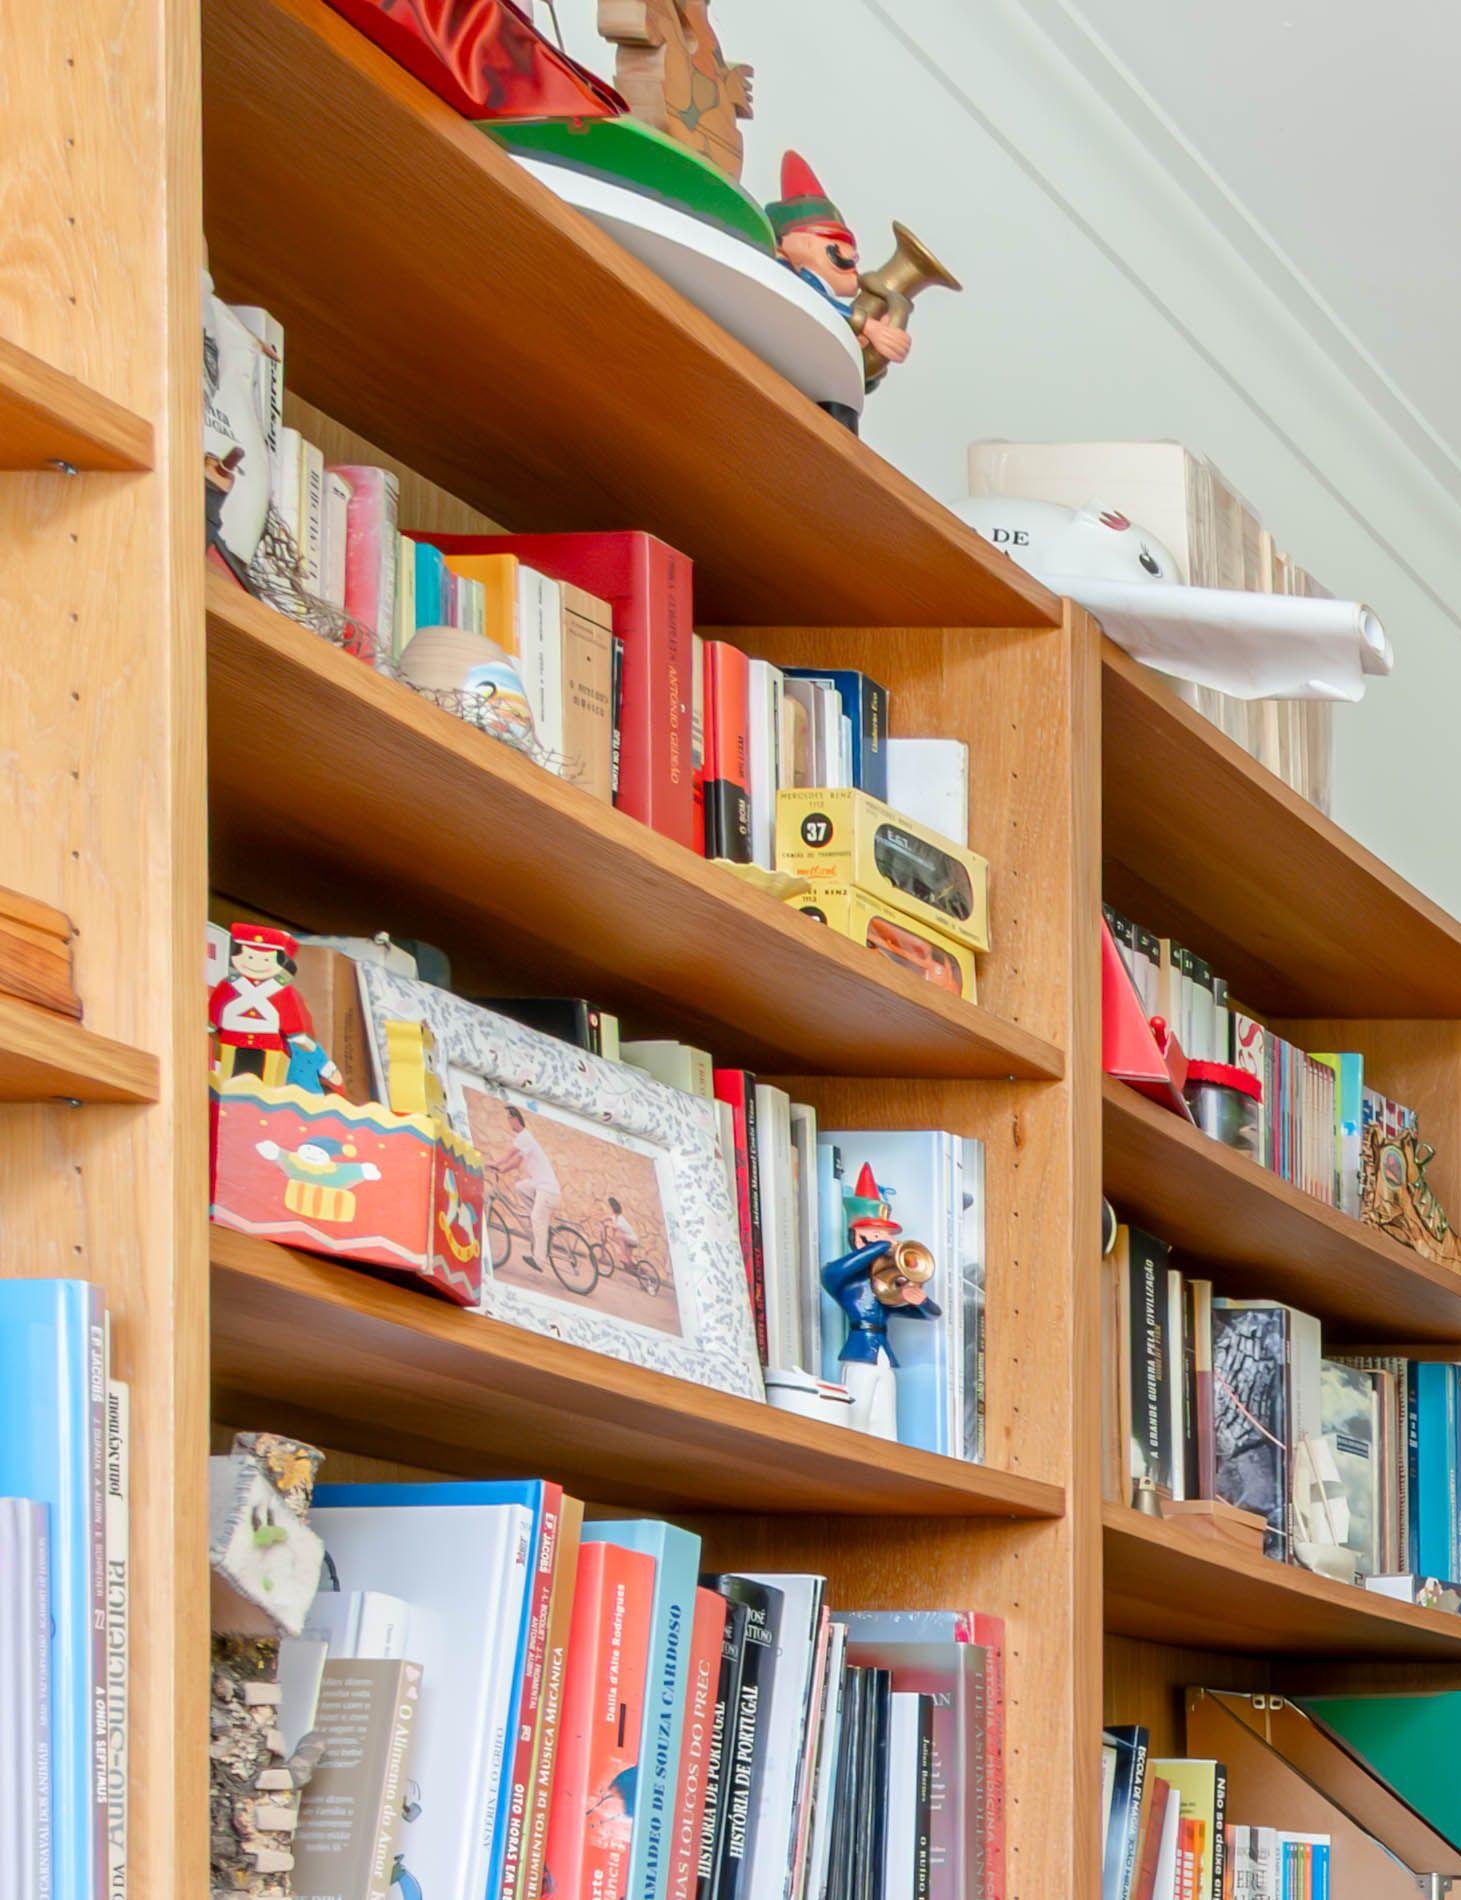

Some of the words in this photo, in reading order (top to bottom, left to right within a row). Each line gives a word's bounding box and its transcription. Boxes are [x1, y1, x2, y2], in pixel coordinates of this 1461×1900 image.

[993, 528, 1030, 547] DE
[806, 822, 827, 842] 37
[1145, 1258, 1155, 1325] CIVILIZAÇÃO
[1147, 1360, 1158, 1402] GUERRA
[1149, 1405, 1160, 1448] GRANDE
[539, 1533, 555, 1574] JACOBS
[613, 1584, 626, 1651] Rodrigues
[609, 1655, 621, 1688] d'Alte
[660, 1604, 683, 1707] CARDOSO
[606, 1691, 618, 1723] Dalila
[695, 1659, 712, 1723] PREC
[95, 1701, 107, 1735] ONDA
[399, 1704, 413, 1720] O
[741, 1685, 759, 1757] PORTUGAL
[654, 1714, 673, 1778] SOUZA
[689, 1731, 705, 1765] DO
[96, 1740, 108, 1804] SEPTIMUS
[736, 1760, 750, 1789] DE
[511, 1783, 524, 1813] OITO
[651, 1783, 665, 1817] DE
[1216, 1777, 1227, 1809] Não
[383, 1803, 398, 1829] do
[679, 1773, 700, 1862] LOUCOS
[730, 1793, 746, 1860] HISTÓRIA
[1215, 1811, 1225, 1831] se
[374, 1833, 394, 1878] Amor
[507, 1817, 522, 1860] HORAS
[1213, 1834, 1224, 1878] deixe
[504, 1864, 516, 1884] EM
[918, 1849, 929, 1893] RUÍDO
